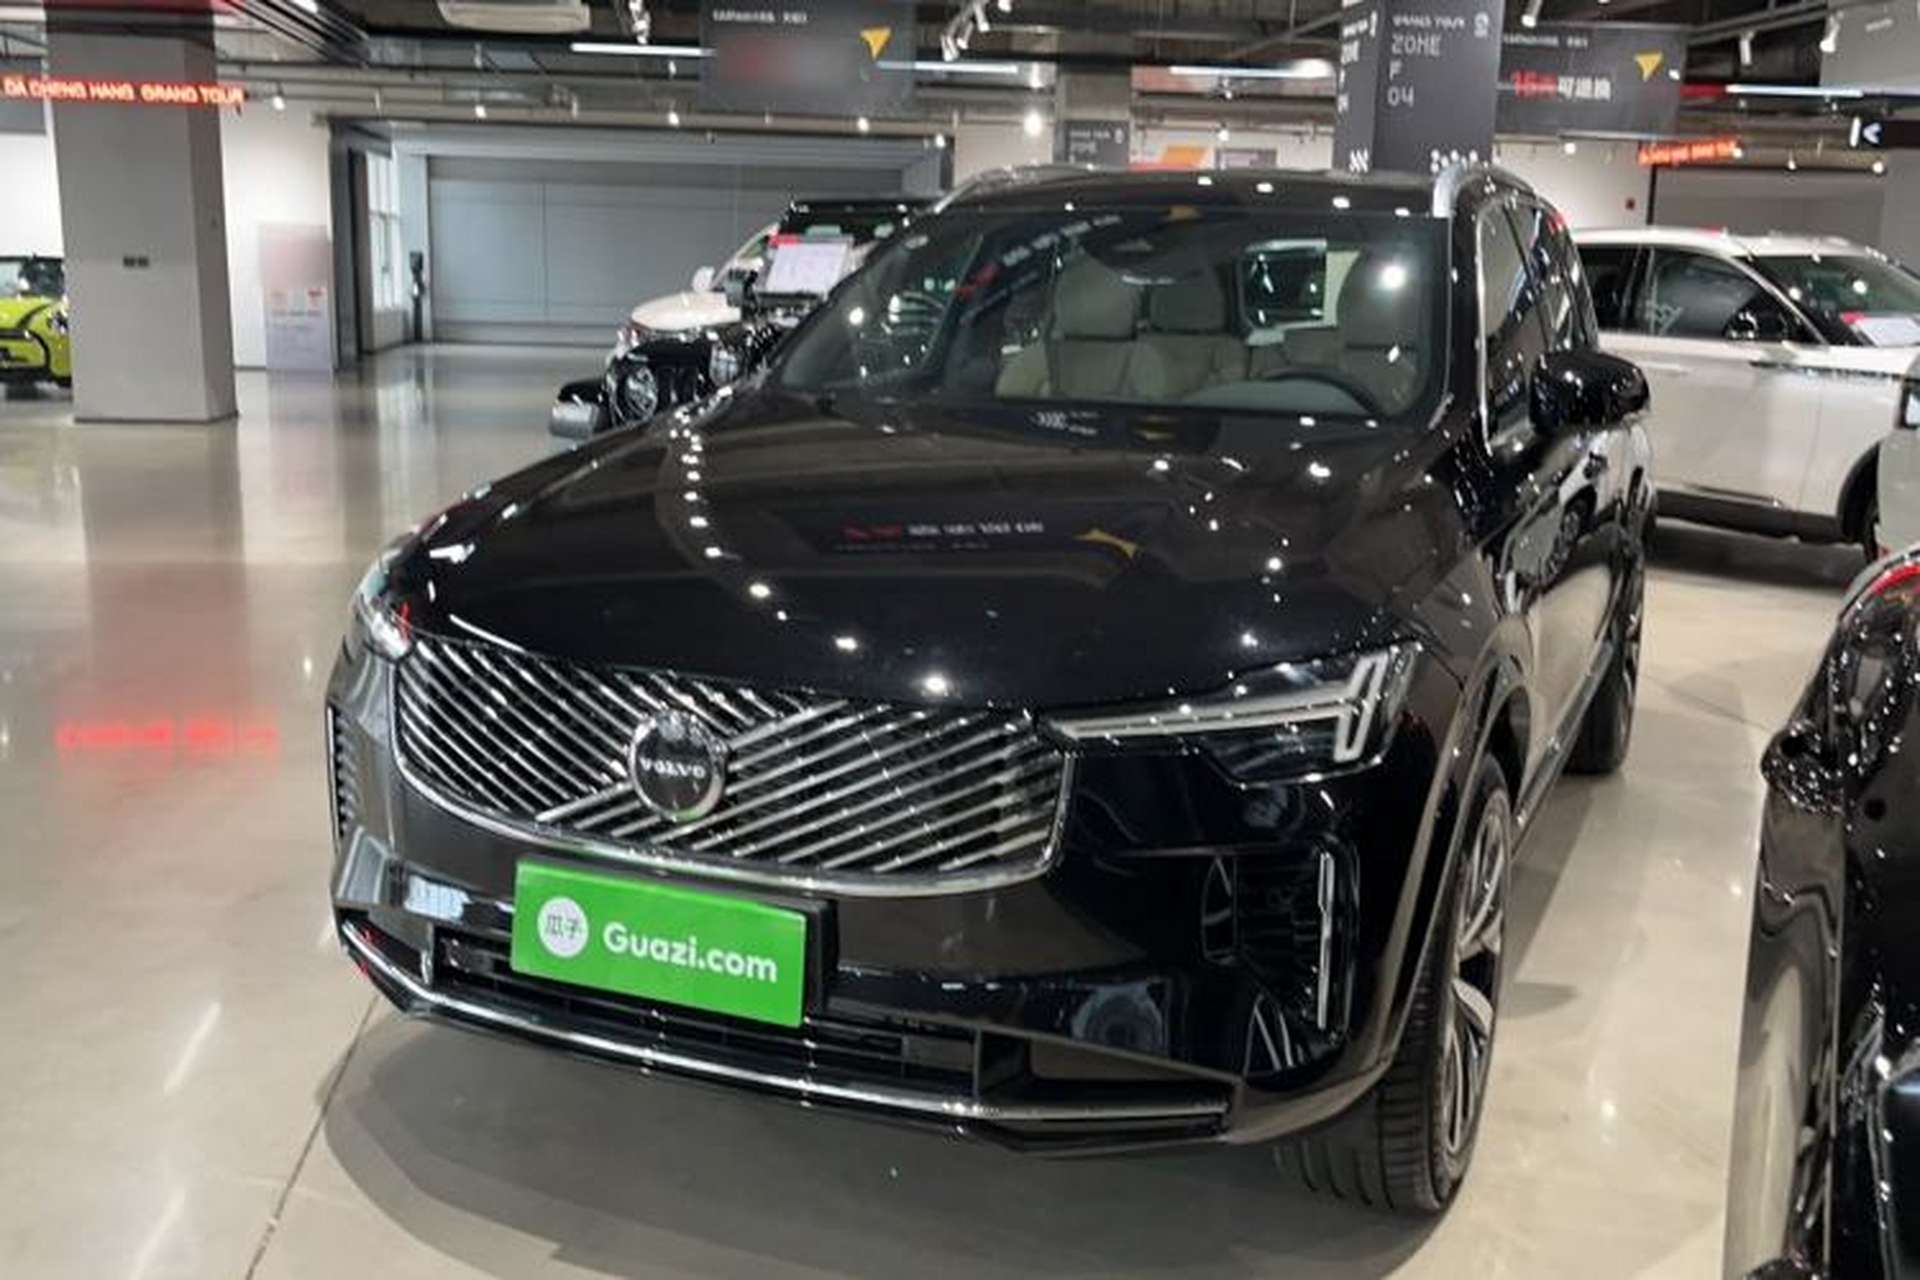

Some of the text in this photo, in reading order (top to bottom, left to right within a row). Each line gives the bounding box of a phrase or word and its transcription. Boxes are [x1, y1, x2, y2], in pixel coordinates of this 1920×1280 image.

[3, 77, 27, 97] DA
[199, 84, 244, 104] TOUR
[1387, 85, 1415, 107] 04
[640, 757, 706, 778] VOLVO
[603, 921, 778, 984] Guazi.com
